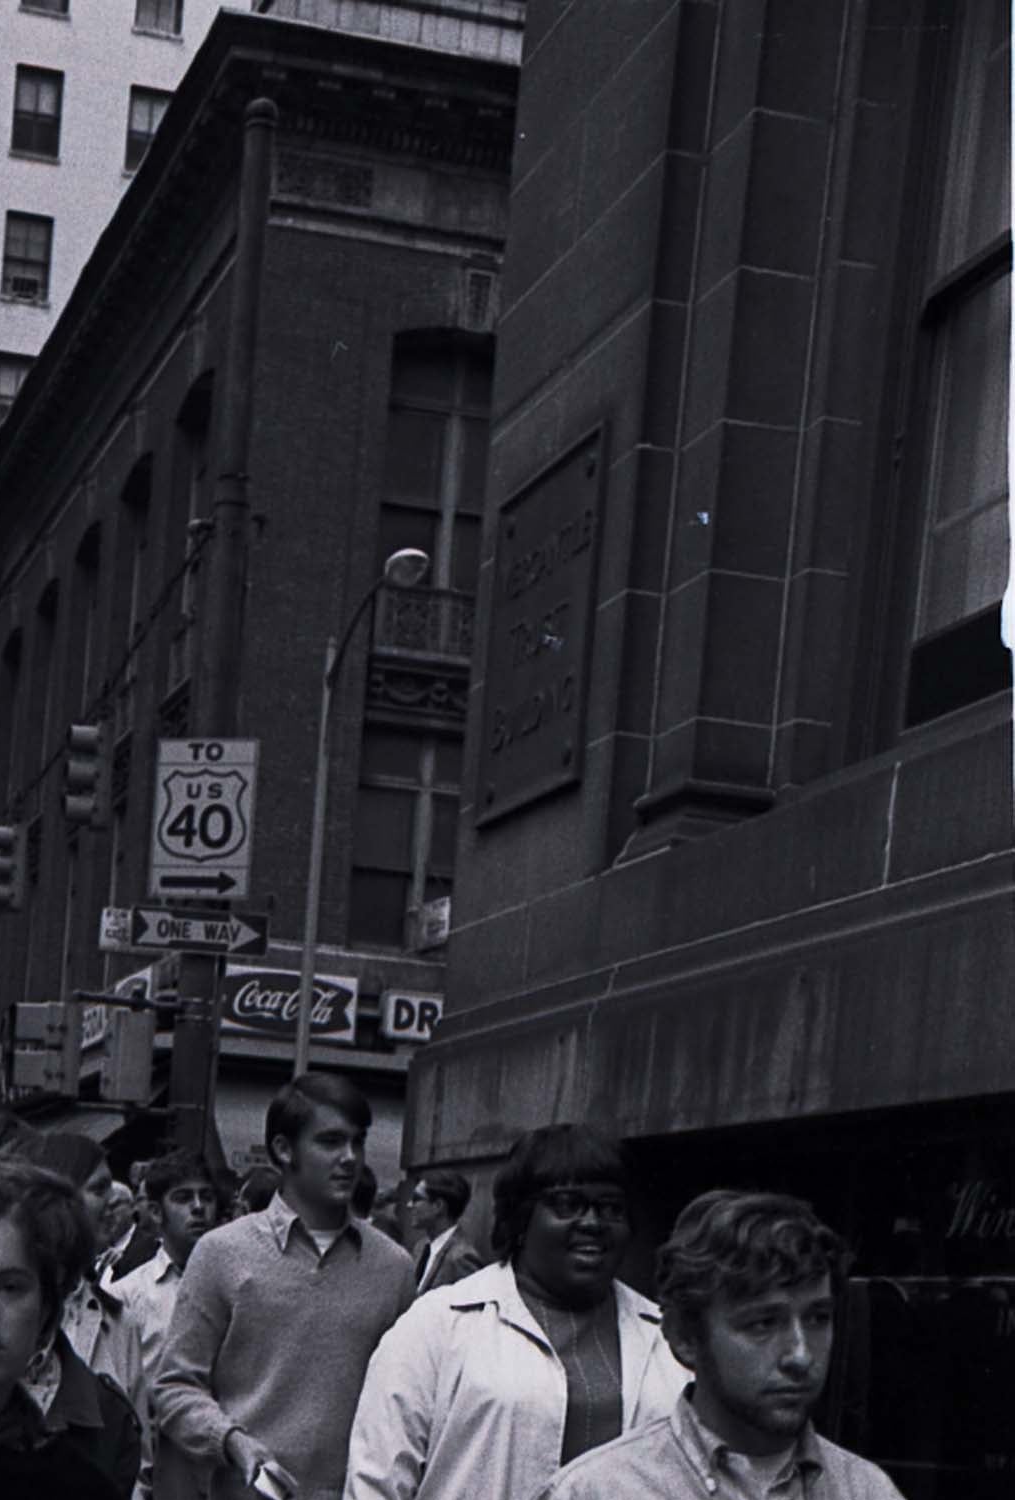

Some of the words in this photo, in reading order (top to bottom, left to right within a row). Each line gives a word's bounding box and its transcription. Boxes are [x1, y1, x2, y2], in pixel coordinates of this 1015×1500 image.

[188, 742, 224, 762] TO
[186, 782, 223, 800] US
[167, 803, 233, 849] 40
[157, 918, 191, 940] ONE
[204, 919, 242, 942] WAY
[234, 980, 338, 1024] Coca-Cla
